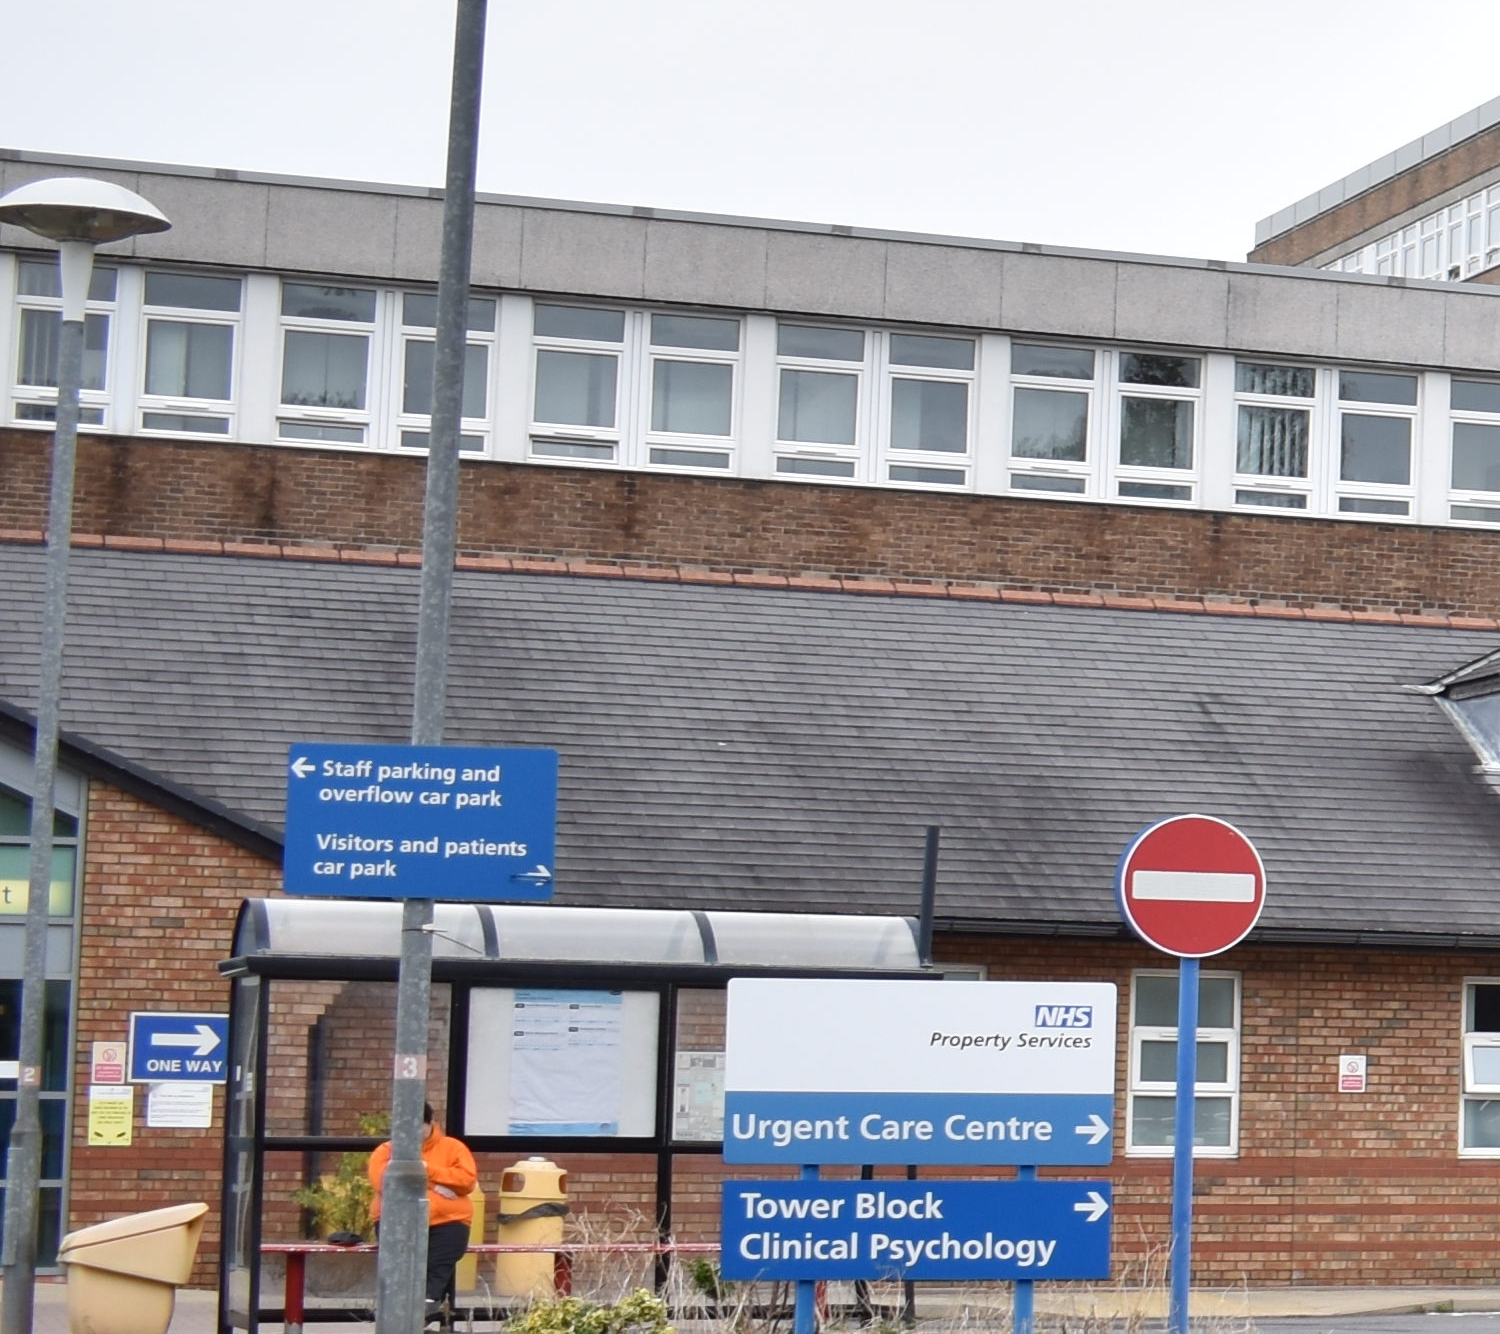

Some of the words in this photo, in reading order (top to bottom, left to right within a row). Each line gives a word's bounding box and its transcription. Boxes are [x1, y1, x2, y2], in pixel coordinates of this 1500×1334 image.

[323, 760, 373, 778] Staff
[378, 762, 456, 785] parking
[461, 765, 500, 782] and
[319, 785, 413, 804] overflow
[419, 791, 450, 805] car
[455, 790, 502, 809] park
[316, 833, 394, 852] Visitors
[400, 837, 439, 854] and
[445, 839, 528, 858] patients
[313, 861, 344, 875] car
[350, 860, 397, 880] park
[1036, 1006, 1091, 1028] NHS
[930, 1032, 1012, 1050] Property
[1017, 1033, 1092, 1049] Services
[24, 1068, 35, 1082] 2
[147, 1059, 181, 1073] ONE
[185, 1060, 223, 1073] WAY
[403, 1057, 418, 1078] 3
[731, 1113, 849, 1147] Urgent
[860, 1114, 934, 1141] Care
[944, 1114, 1053, 1141] Centre
[740, 1192, 845, 1219] Tower
[855, 1192, 943, 1220] Block
[739, 1232, 857, 1260] Clinical
[870, 1233, 1056, 1267] Psychology
